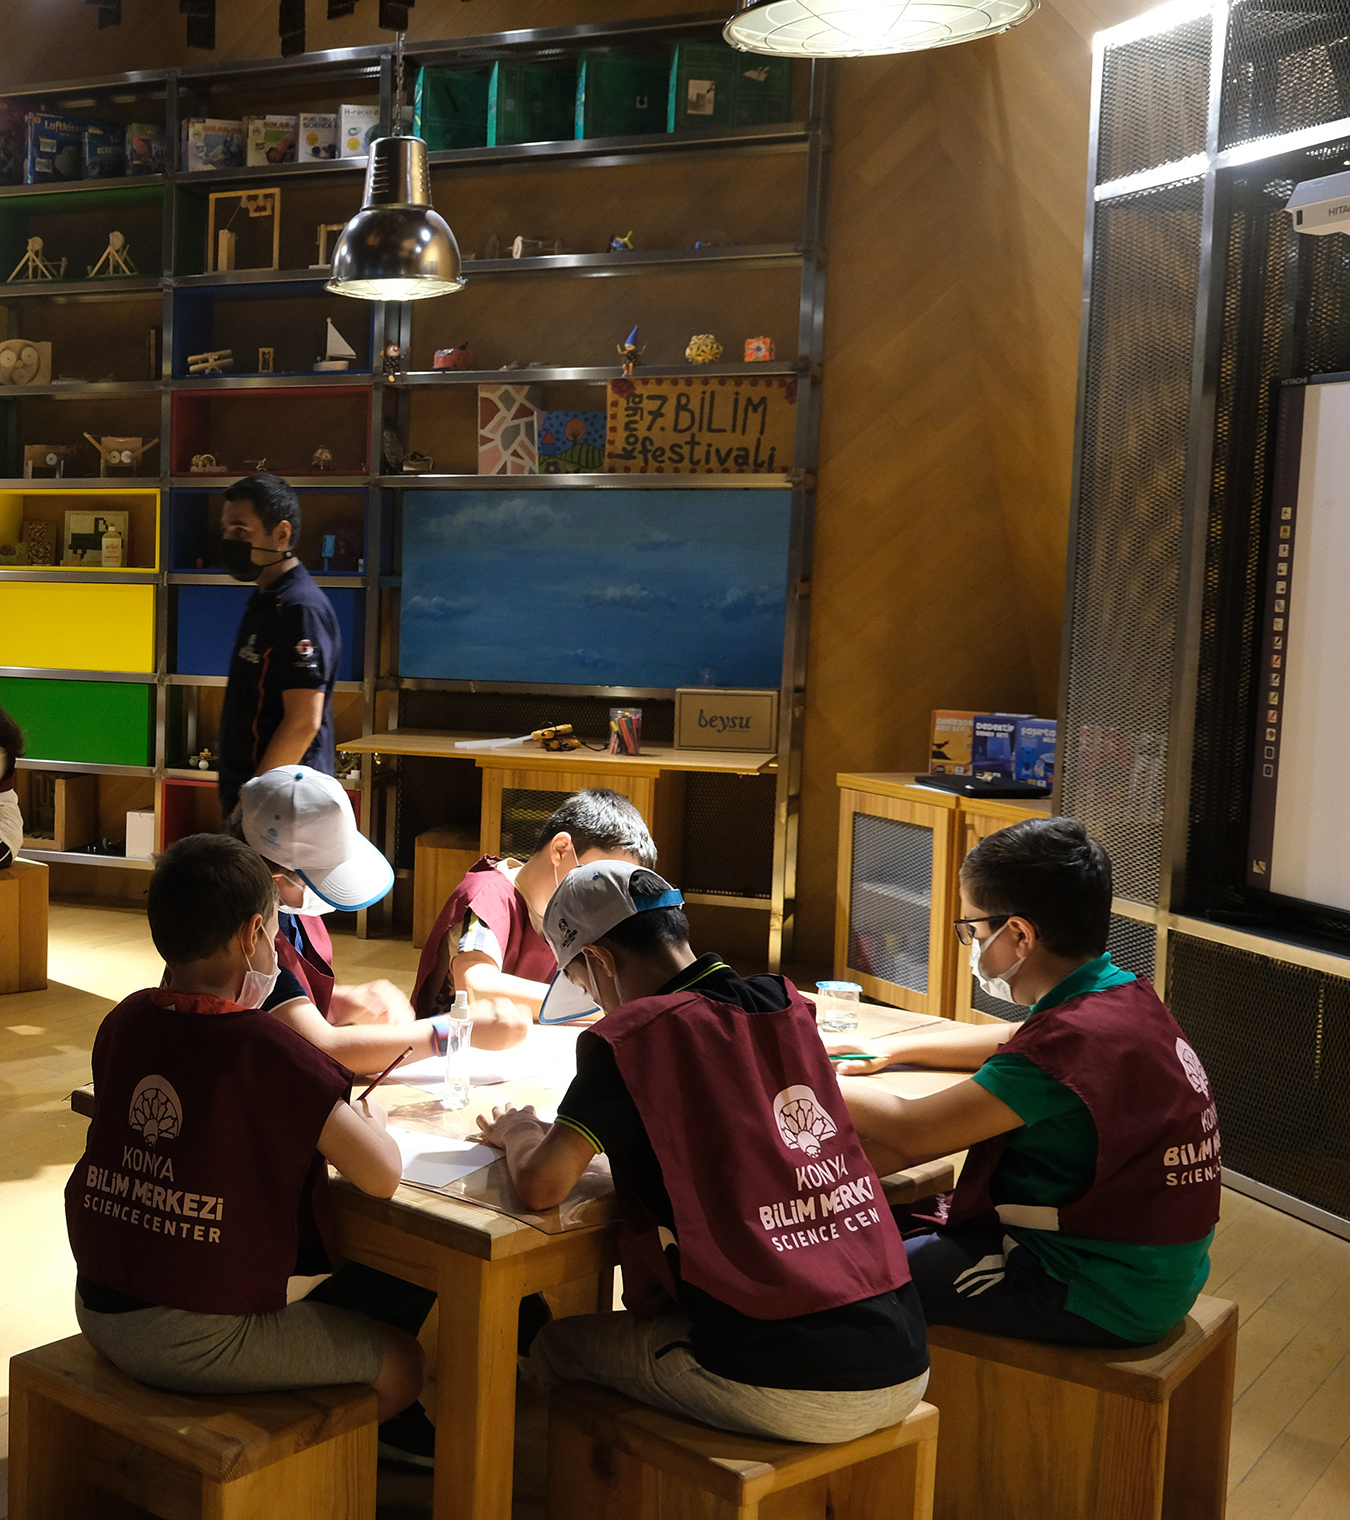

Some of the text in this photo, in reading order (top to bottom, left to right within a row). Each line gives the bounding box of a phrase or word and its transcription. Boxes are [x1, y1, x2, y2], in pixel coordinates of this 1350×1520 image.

[1328, 204, 1350, 217] HITA
[637, 432, 777, 469] festivali
[698, 708, 751, 733] beysu
[121, 1145, 175, 1183] KONYA
[795, 1153, 849, 1192] KONYA
[83, 1193, 222, 1244] SCIENCE CENTER
[771, 1222, 840, 1252] SCIENCE
